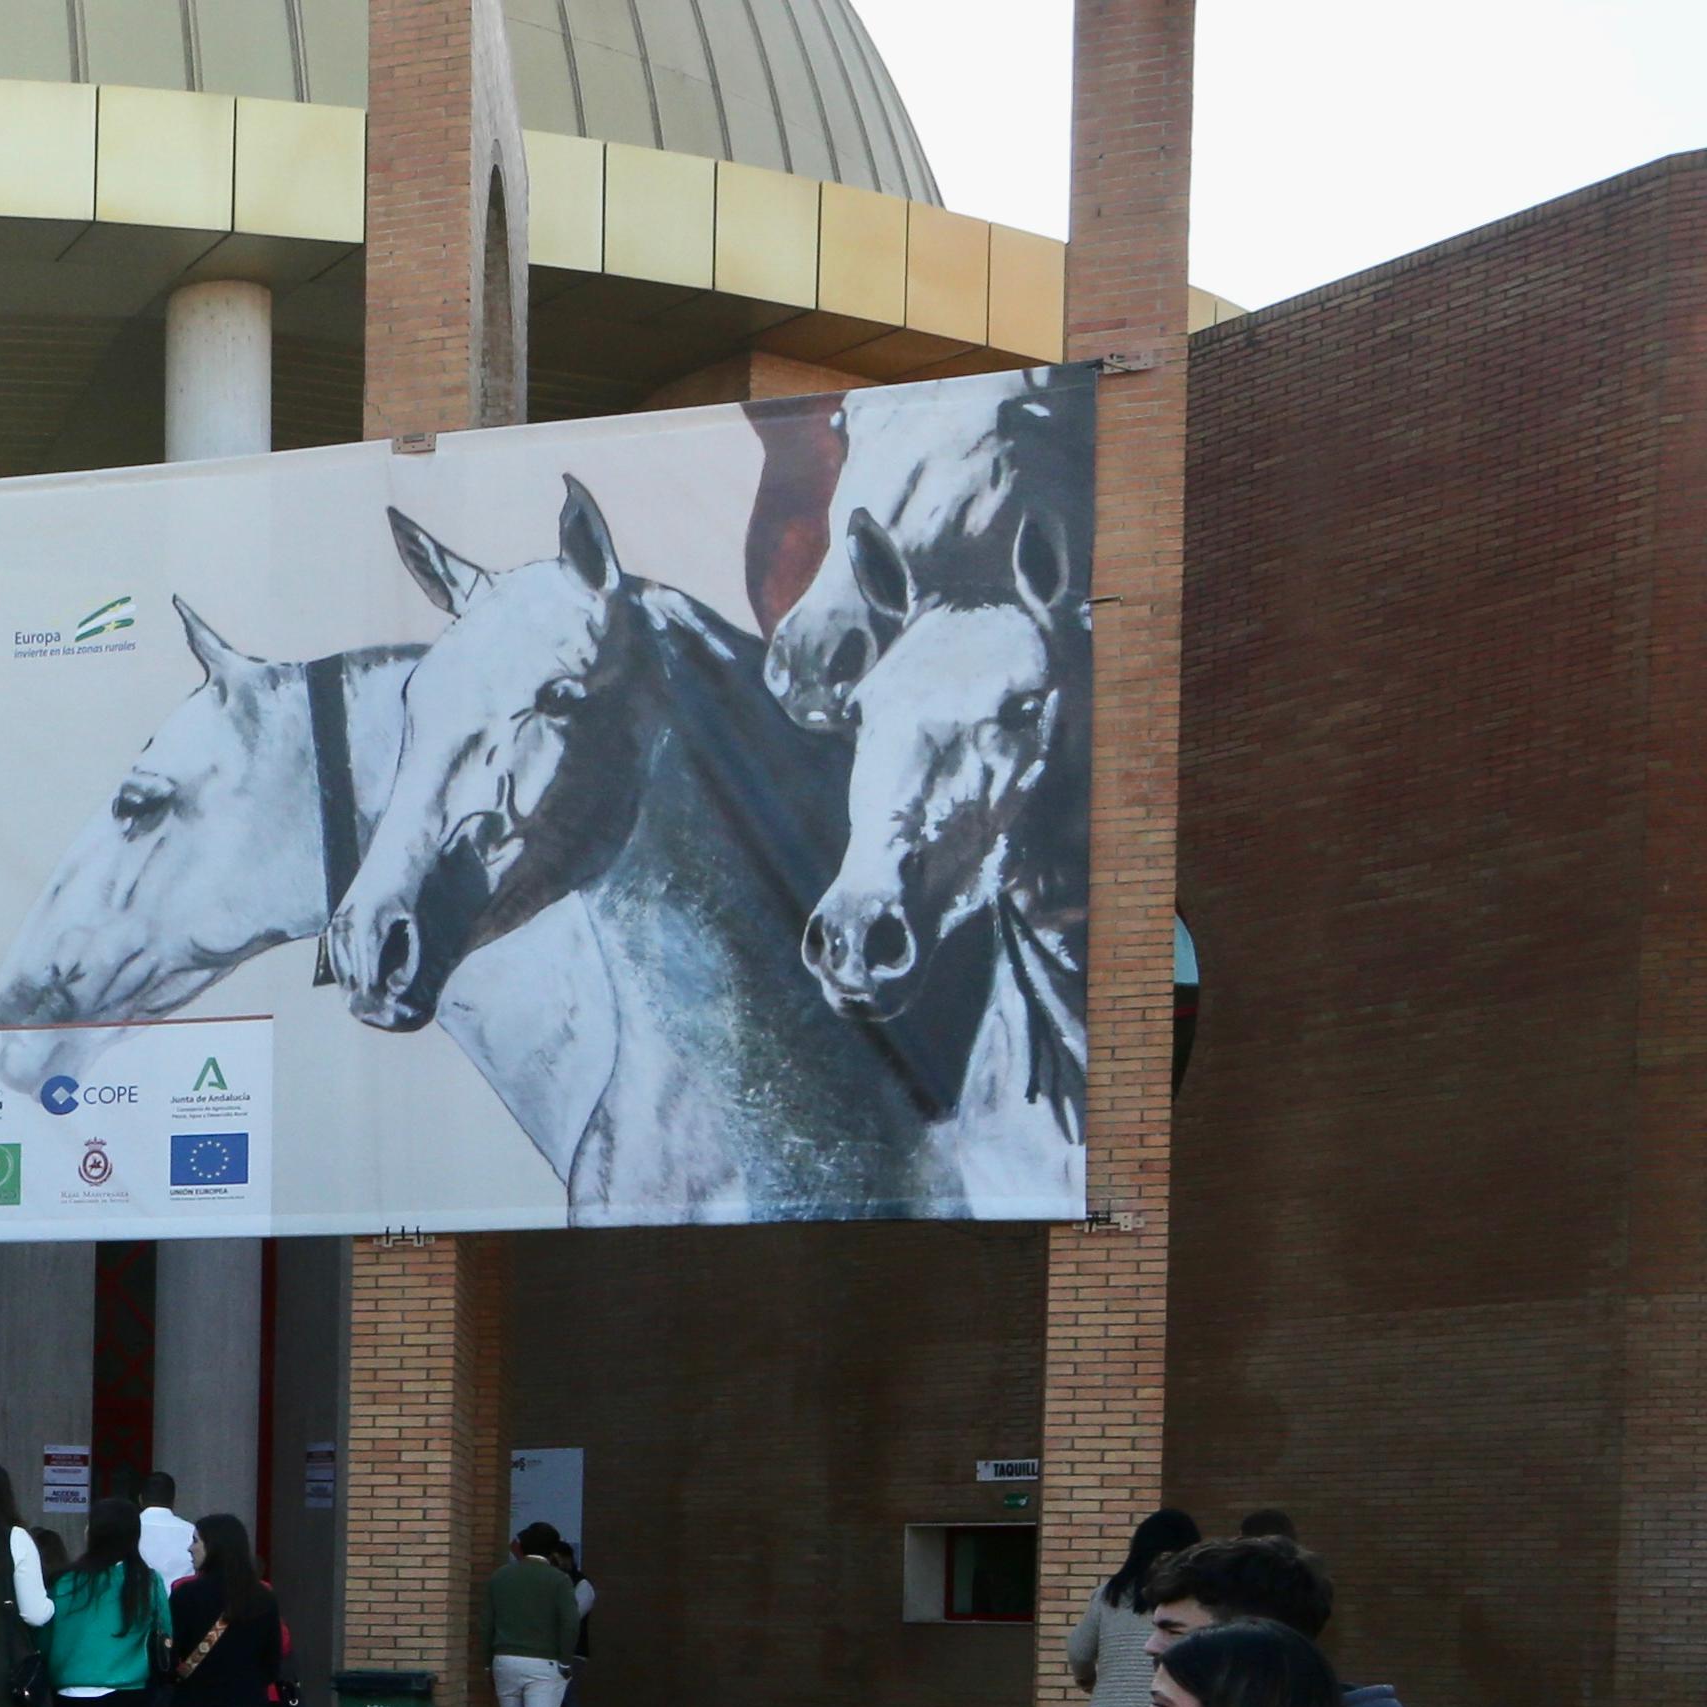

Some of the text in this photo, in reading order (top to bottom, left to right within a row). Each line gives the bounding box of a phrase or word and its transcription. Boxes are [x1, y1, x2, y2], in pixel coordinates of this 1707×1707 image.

[14, 631, 61, 646] Europa
[105, 640, 136, 652] rurales
[83, 1085, 138, 1105] COPE
[171, 1092, 251, 1104] Junta de Andalucía
[170, 1187, 228, 1196] UNIÓN EUROPEA
